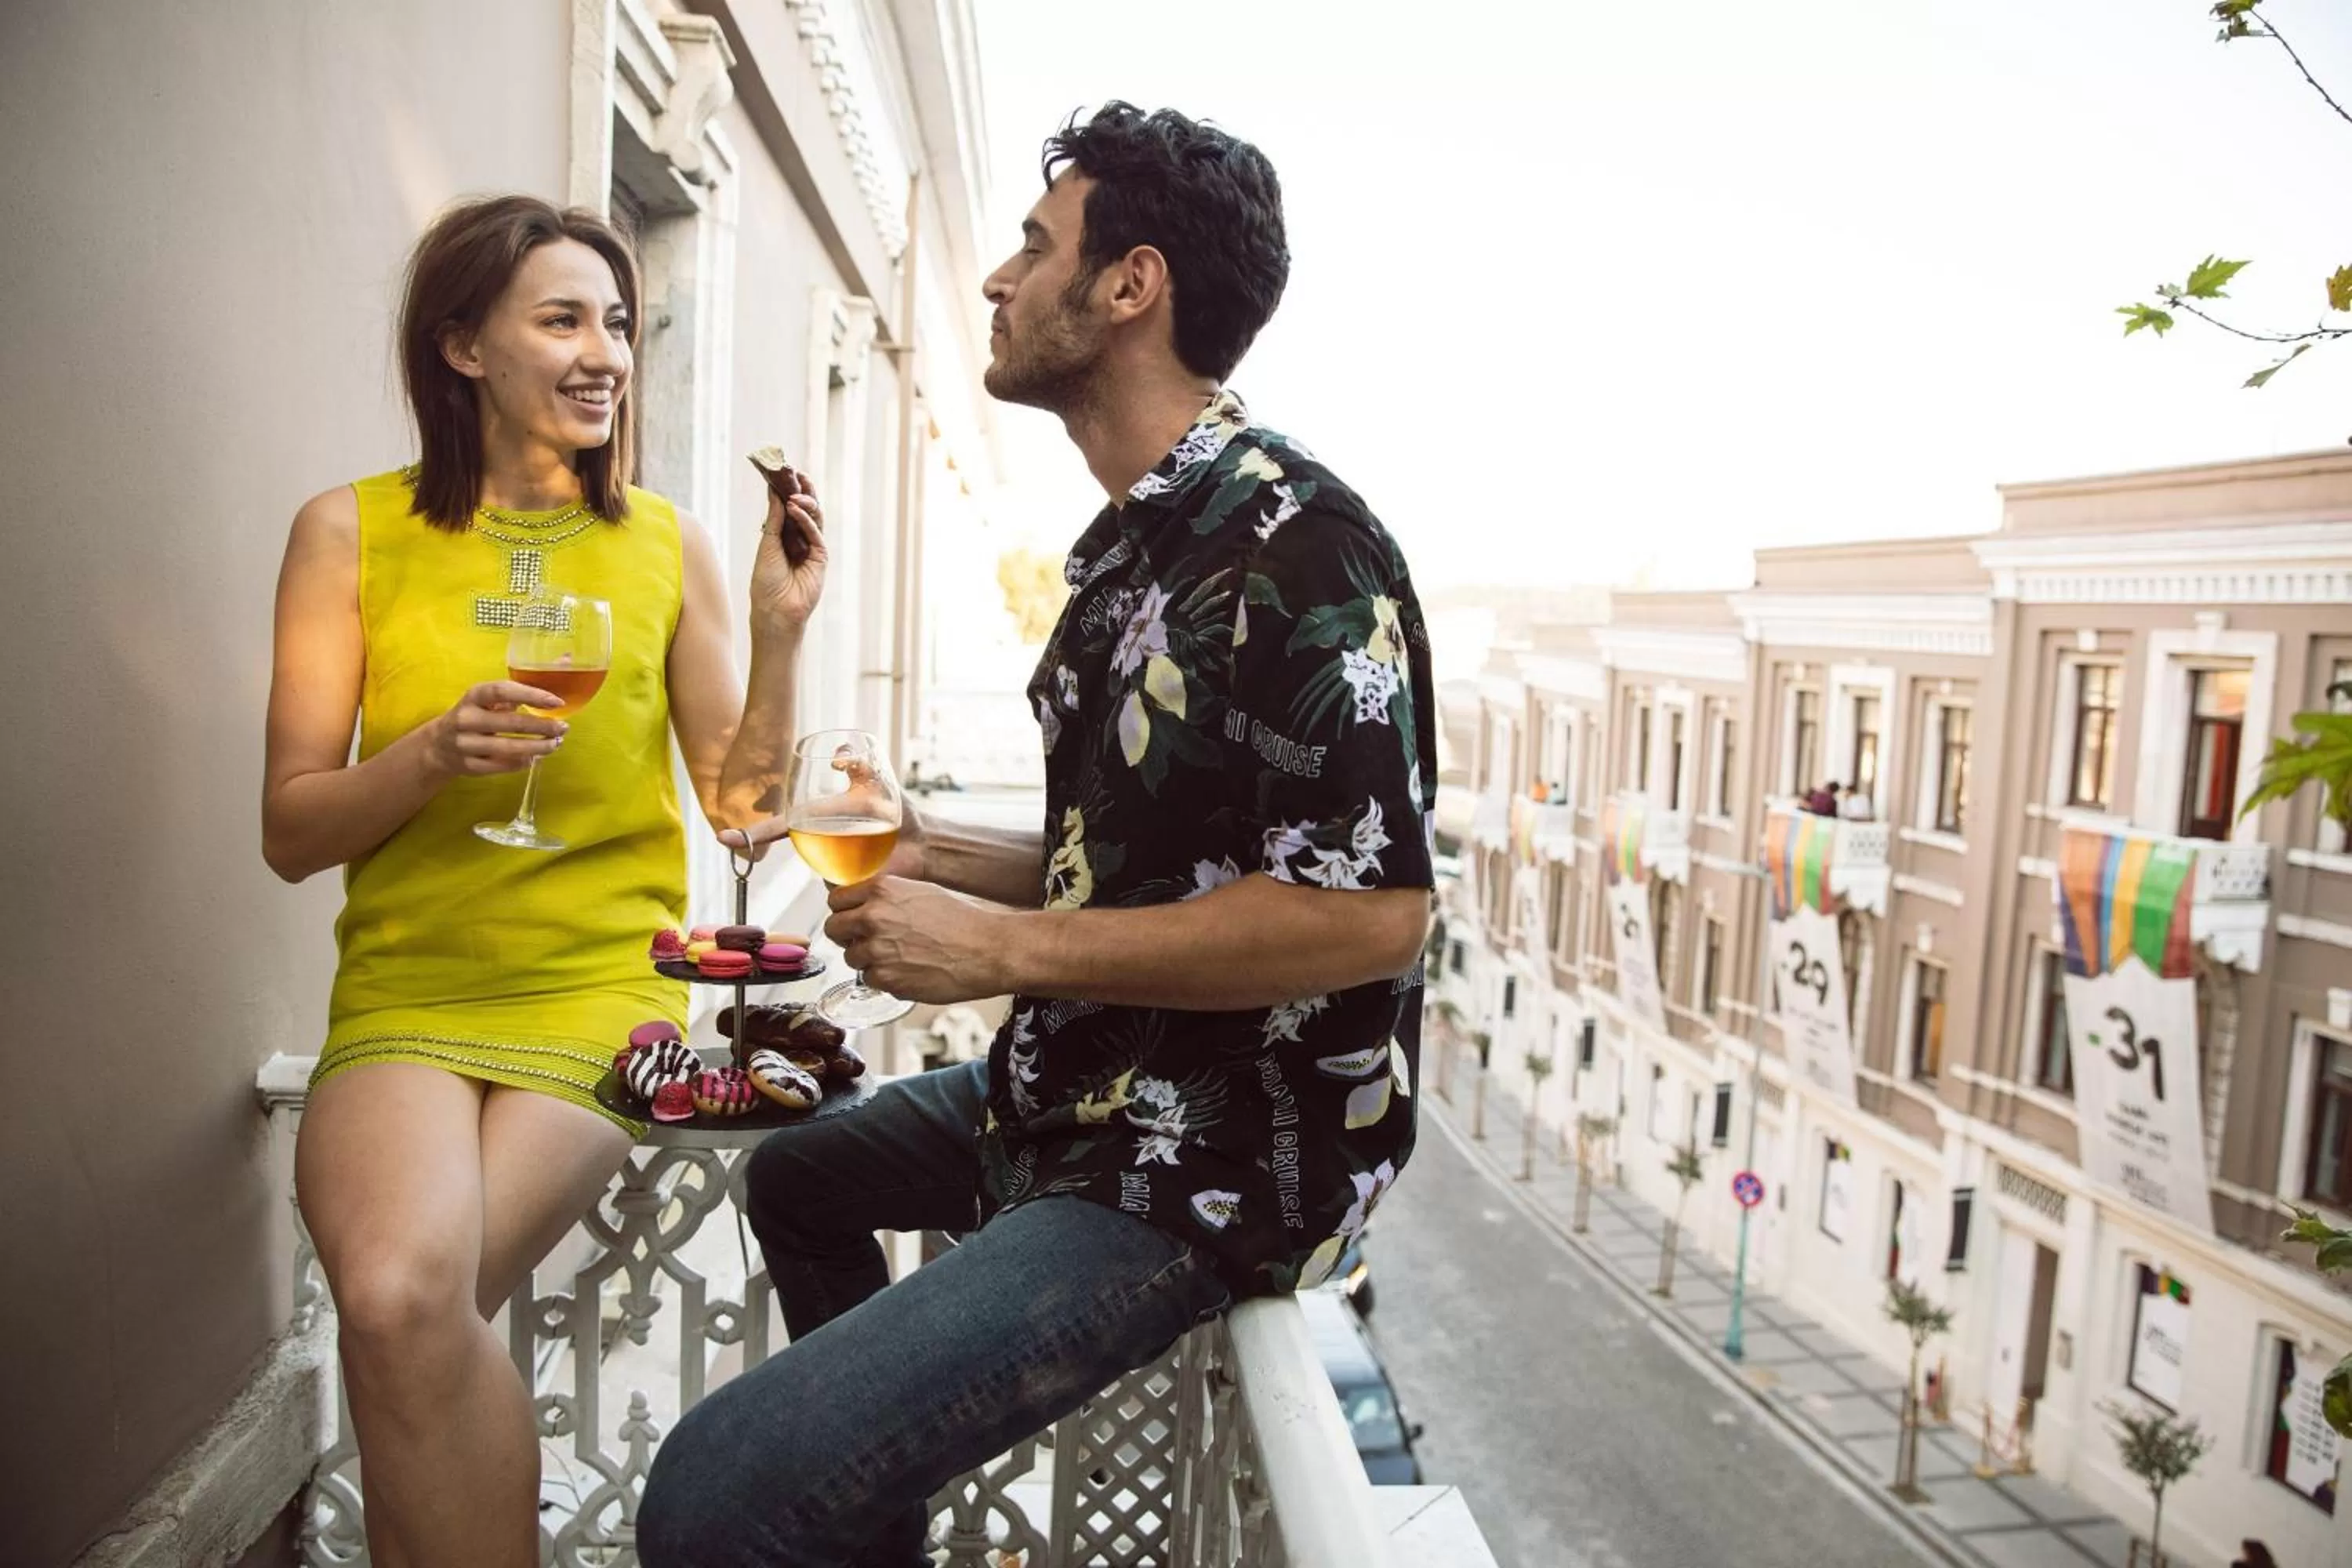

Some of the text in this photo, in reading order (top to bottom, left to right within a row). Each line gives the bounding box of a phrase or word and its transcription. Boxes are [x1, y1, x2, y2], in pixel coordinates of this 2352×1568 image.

[1251, 719, 1327, 778] CRUISE
[1790, 941, 1829, 1007] 29
[2103, 1005, 2165, 1102] 31
[1272, 1131, 1305, 1229] CRUISE
